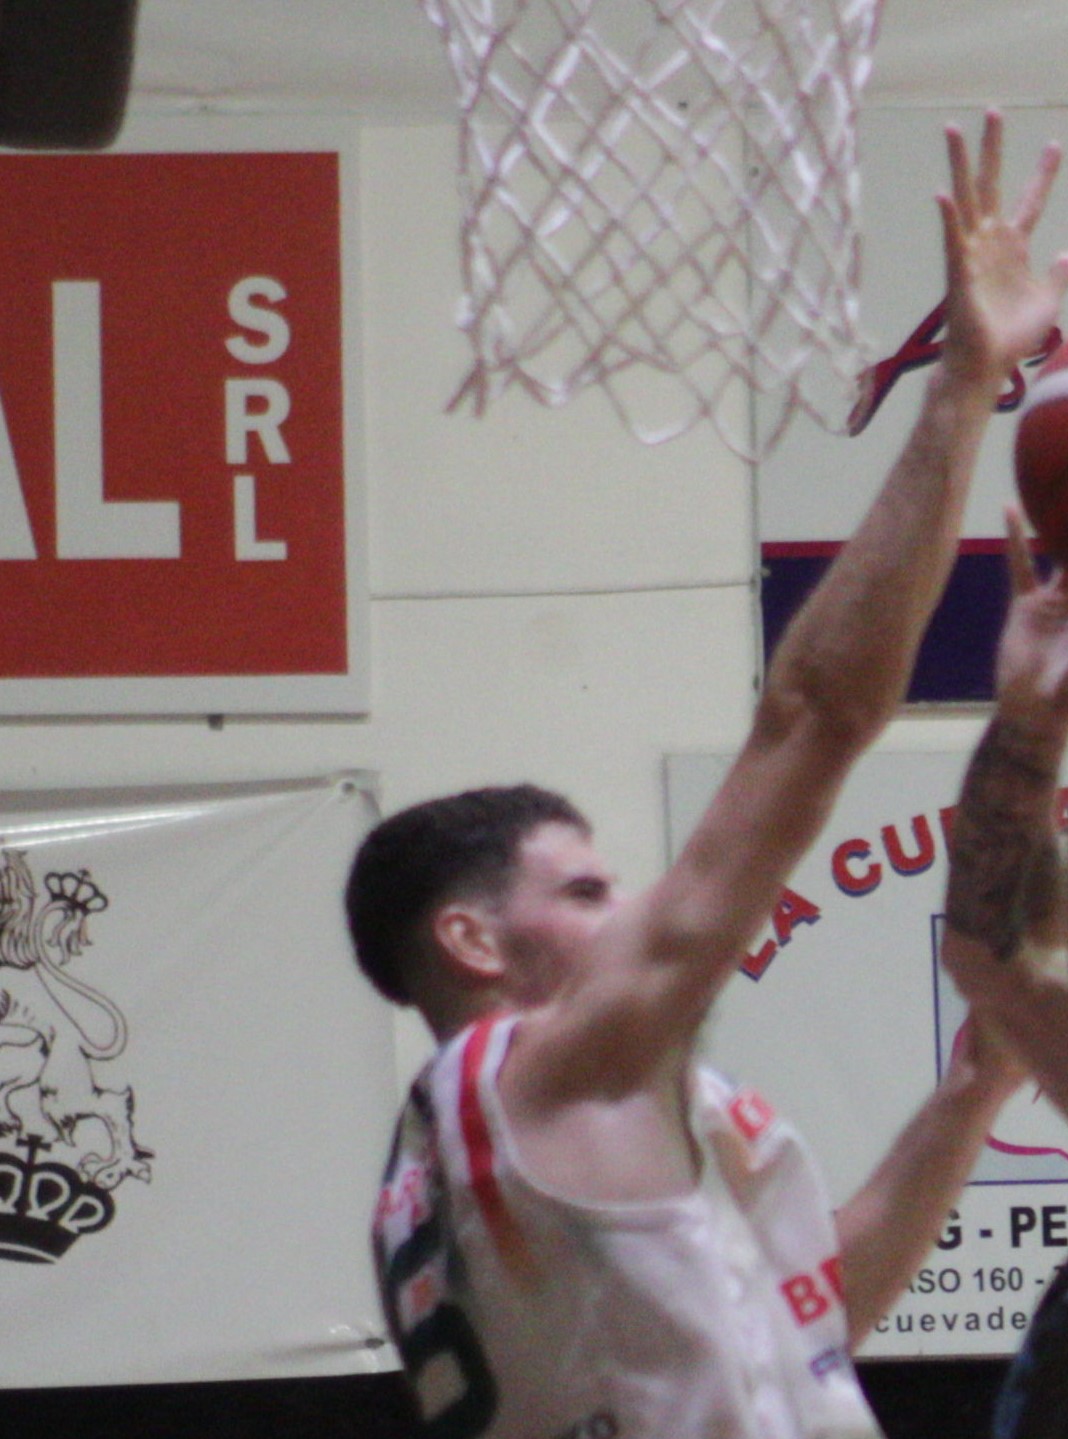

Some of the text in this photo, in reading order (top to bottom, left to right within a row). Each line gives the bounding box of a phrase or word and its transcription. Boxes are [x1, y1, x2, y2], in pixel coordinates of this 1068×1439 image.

[0, 280, 181, 560] L
[973, 1266, 1023, 1292] 160
[874, 1306, 1028, 1334] cuevade
